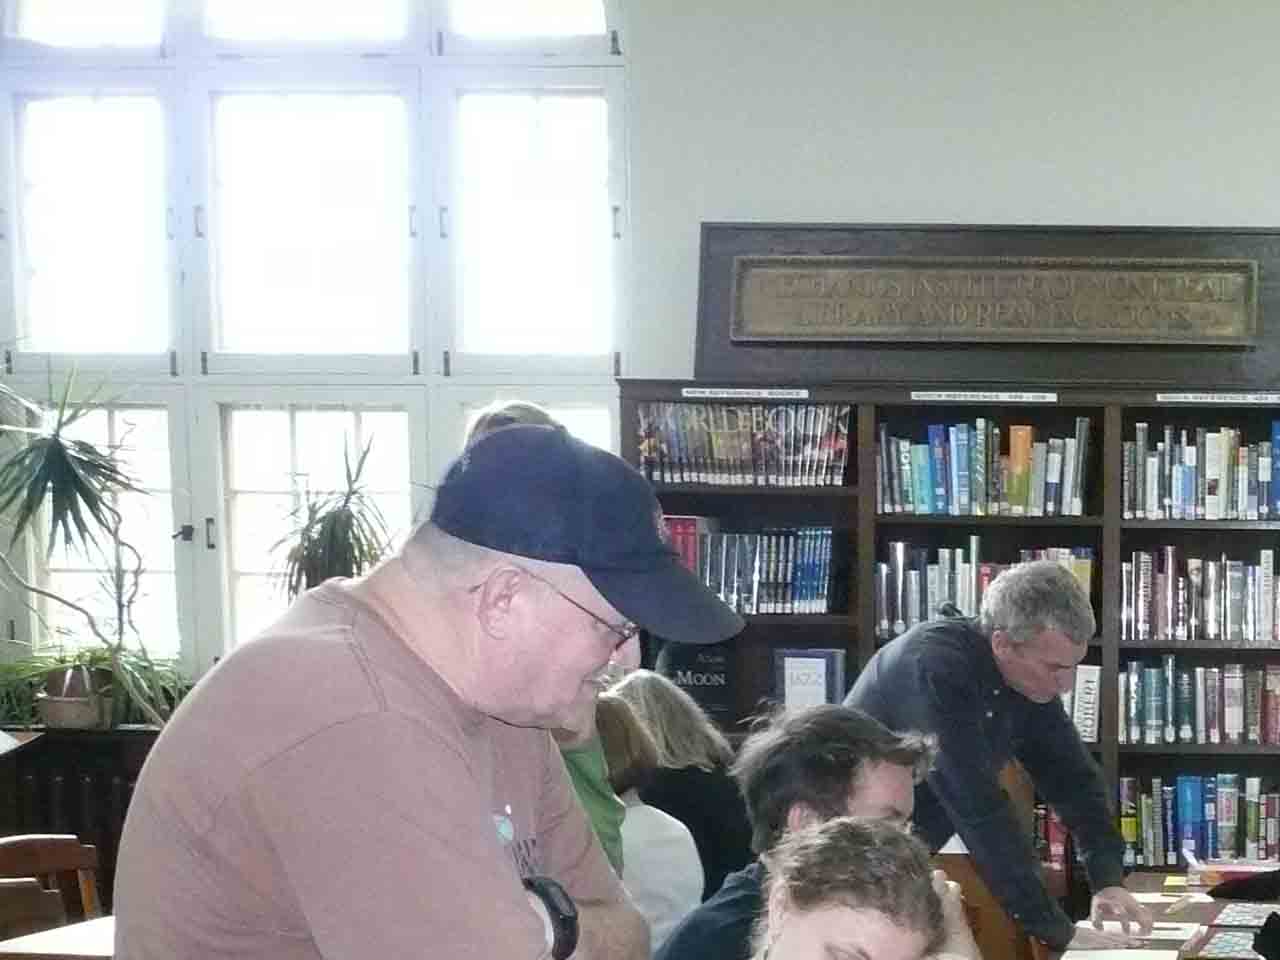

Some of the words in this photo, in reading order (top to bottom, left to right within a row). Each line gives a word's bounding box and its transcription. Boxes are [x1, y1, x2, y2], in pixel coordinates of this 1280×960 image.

[637, 401, 747, 432] WORLD
[750, 404, 851, 434] BOOK
[676, 669, 727, 686] MOON
